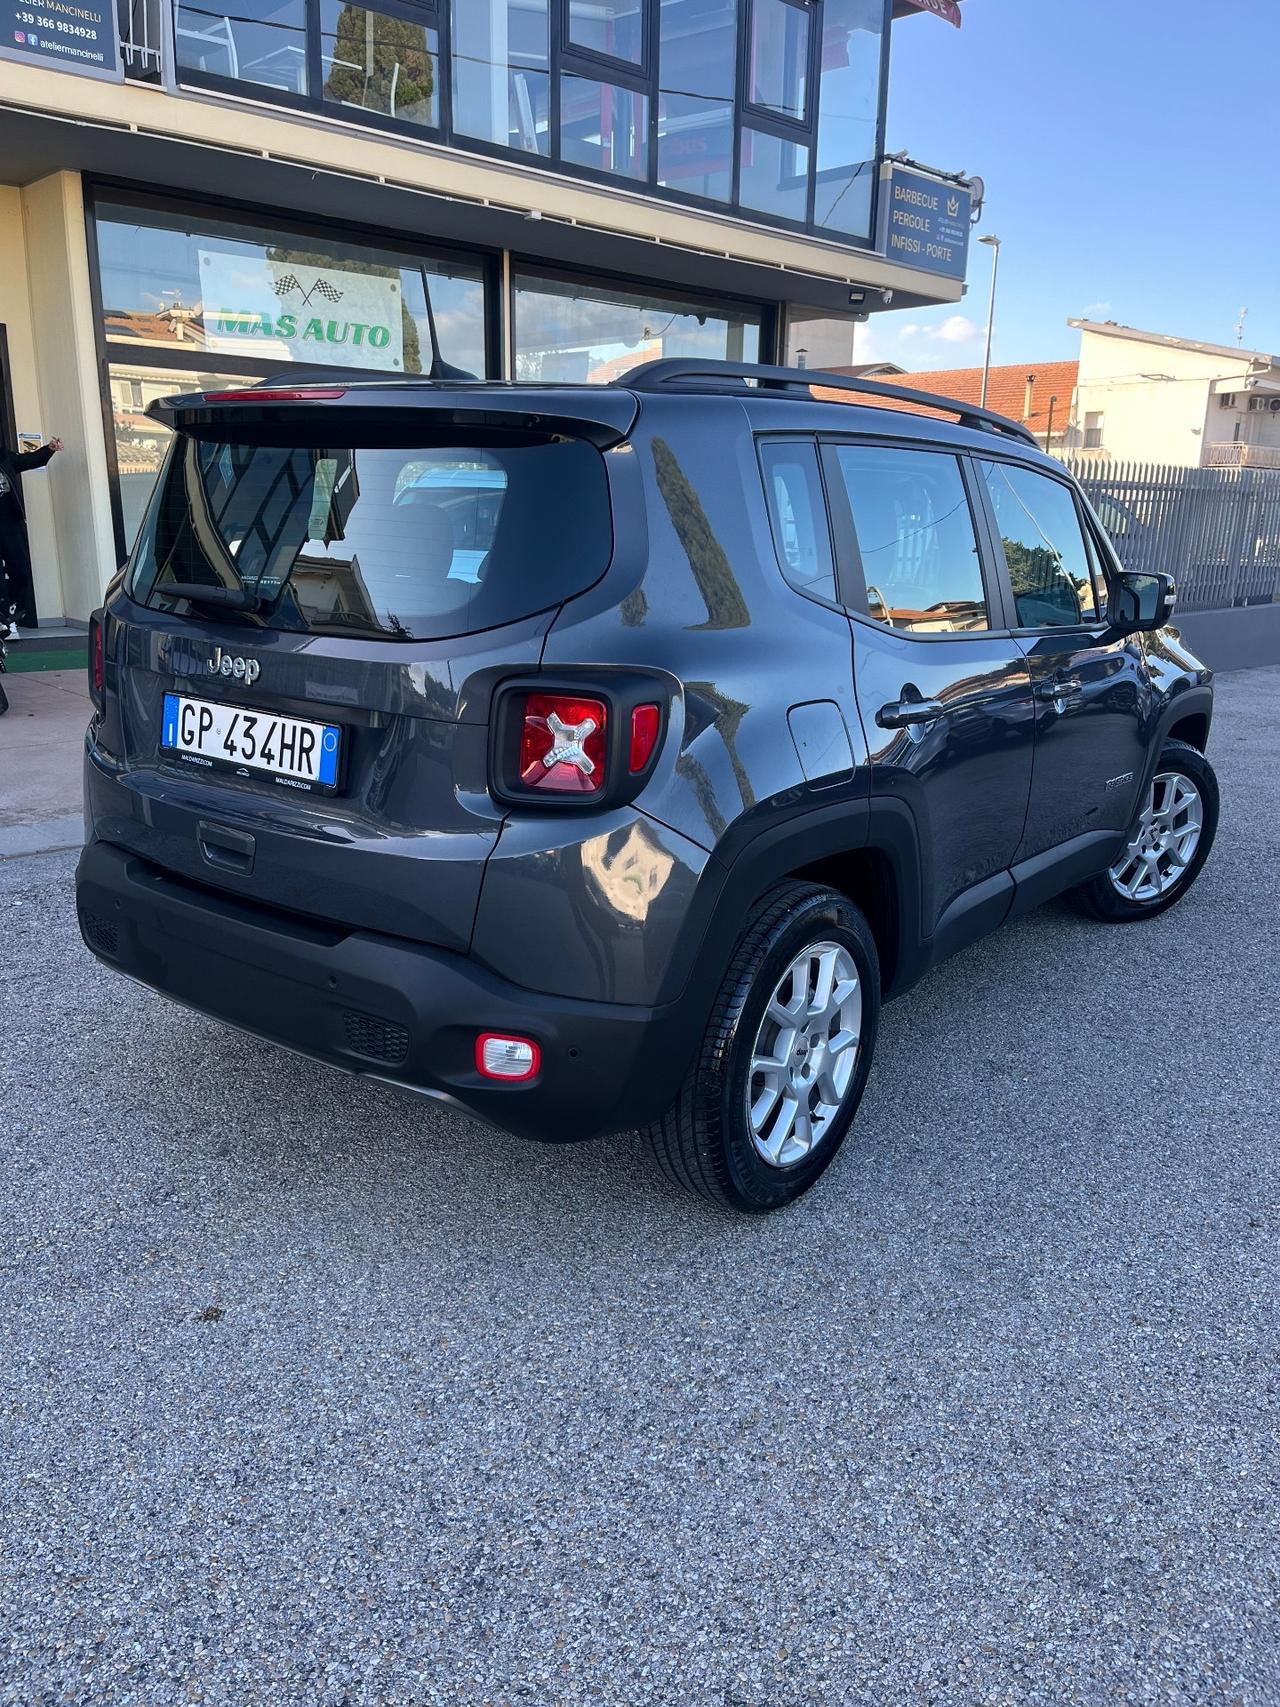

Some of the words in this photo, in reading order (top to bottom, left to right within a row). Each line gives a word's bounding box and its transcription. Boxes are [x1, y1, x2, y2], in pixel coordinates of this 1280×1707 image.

[46, 0, 102, 23] MANCINELLI
[15, 12, 34, 24] +39
[37, 16, 55, 29] 366
[57, 22, 97, 40] 9834928
[40, 40, 104, 62] ateliermancinelli
[894, 185, 939, 211] BARBECUE
[892, 209, 931, 233] PERGOLE
[891, 233, 921, 253] INFISSI
[926, 243, 952, 262] PORTE
[217, 307, 298, 339] MAS
[302, 318, 392, 349] AUTO
[206, 647, 261, 685] Jeep
[181, 703, 214, 749] GP
[223, 713, 316, 775] 434HR
